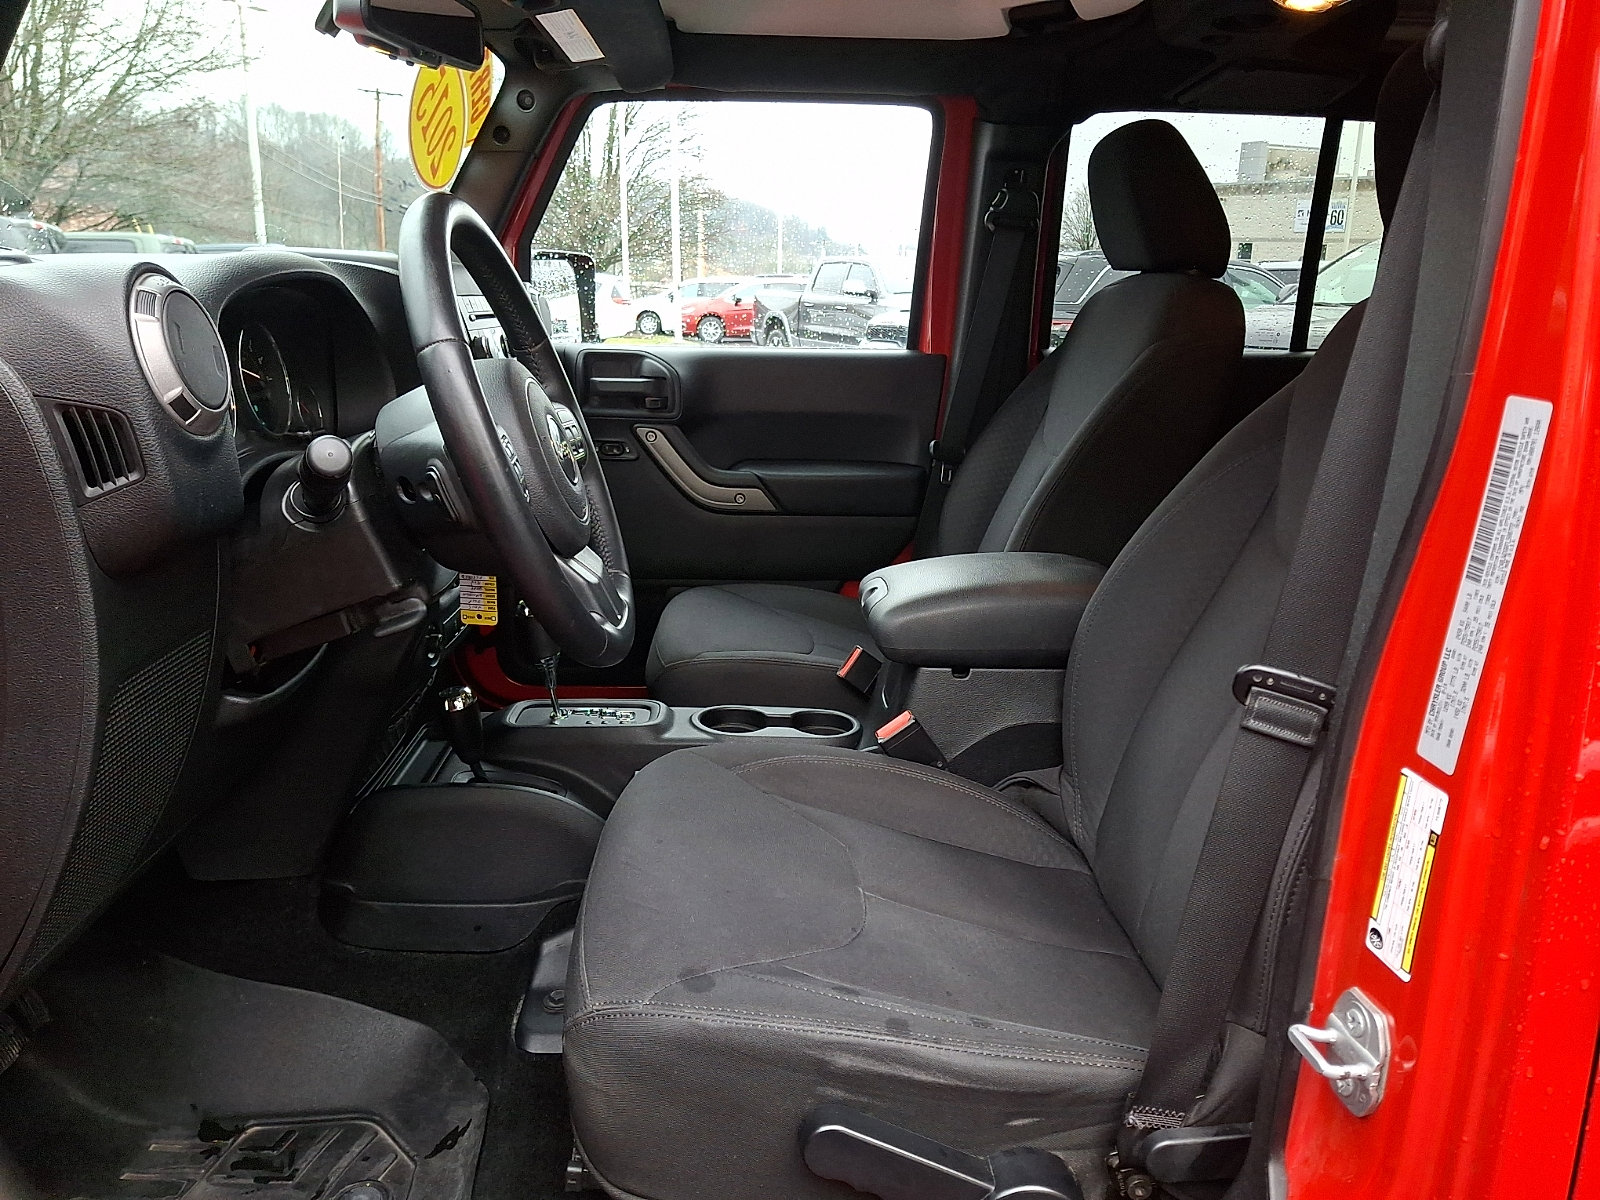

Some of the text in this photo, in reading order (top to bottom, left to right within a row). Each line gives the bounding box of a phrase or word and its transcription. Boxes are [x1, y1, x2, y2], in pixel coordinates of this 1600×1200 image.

[1428, 683, 1442, 717] CHRYSLER
[1437, 659, 1449, 685] GROUP
[1443, 647, 1452, 660] LLC
